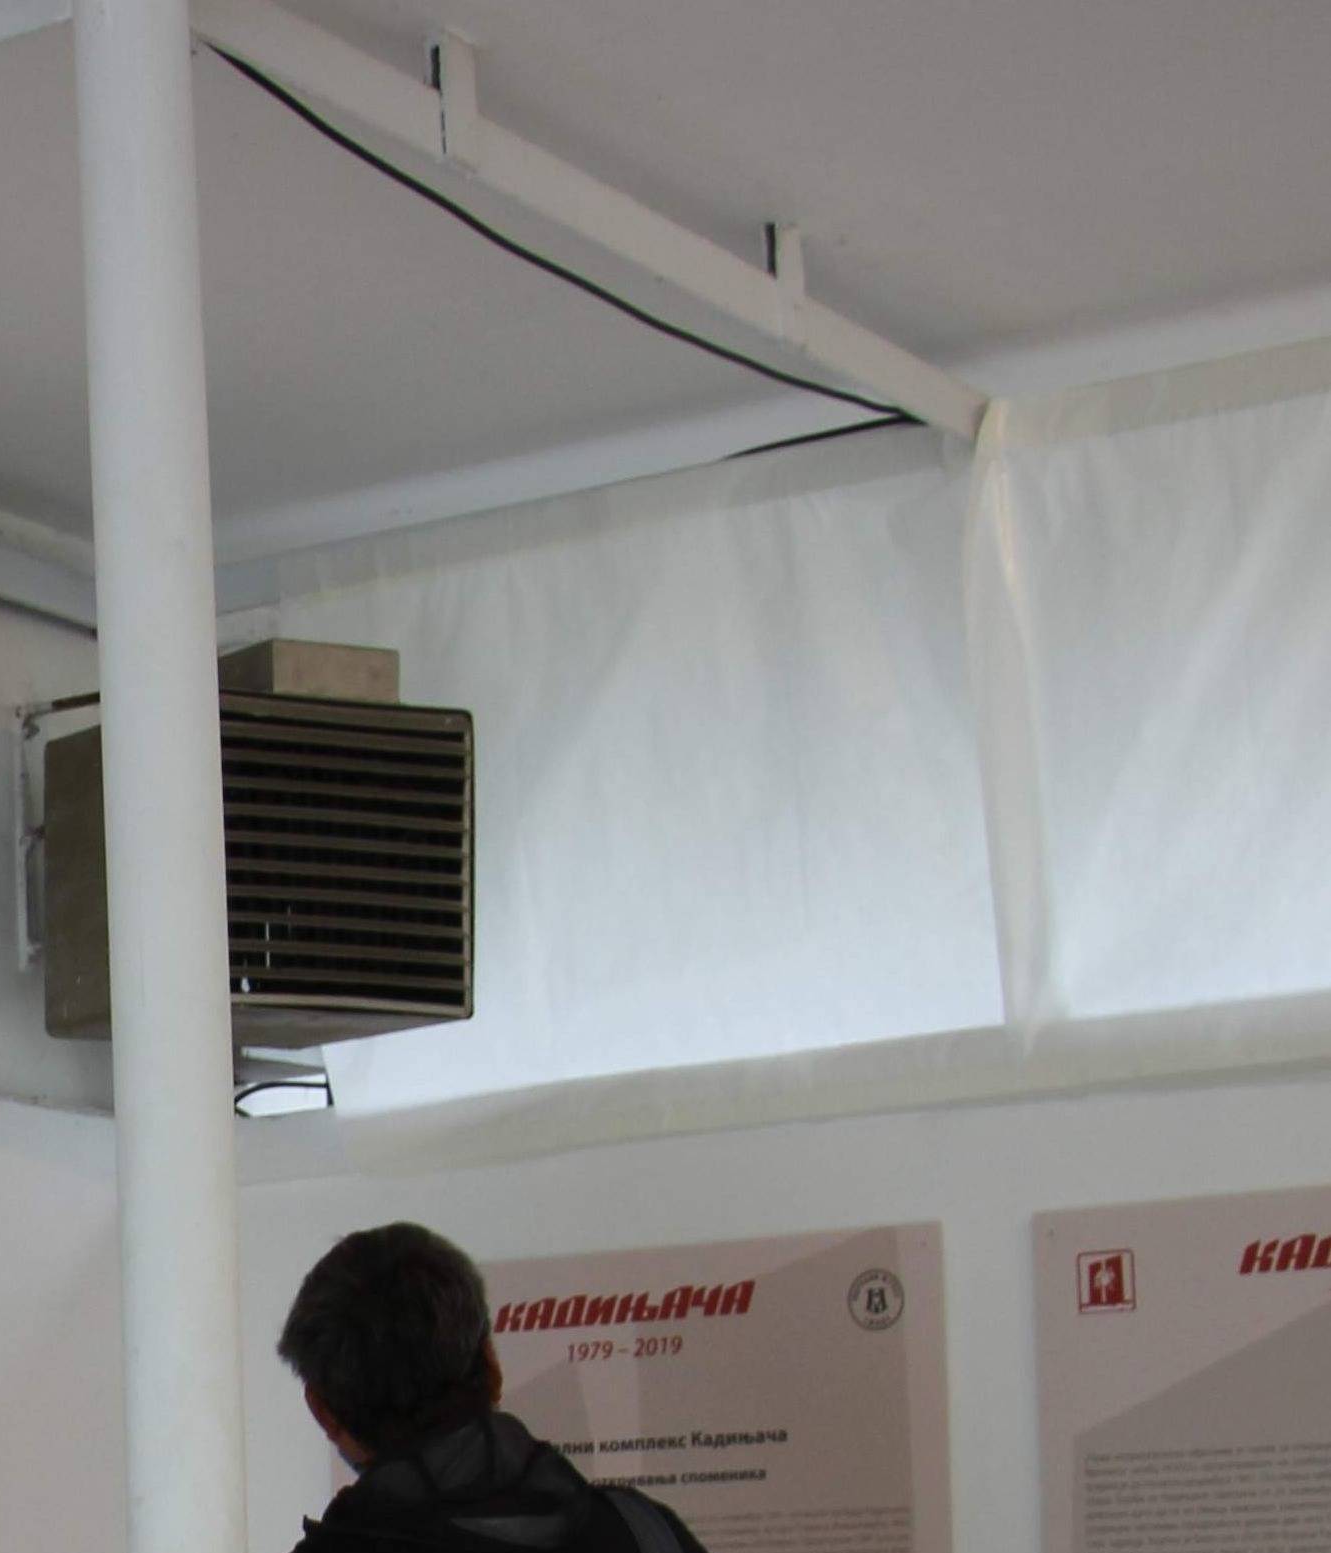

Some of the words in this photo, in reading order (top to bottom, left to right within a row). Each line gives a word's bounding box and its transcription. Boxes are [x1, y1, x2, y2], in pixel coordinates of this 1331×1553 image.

[494, 1280, 755, 1333] КАДИЊАЧА
[567, 1341, 614, 1363] 1979
[633, 1335, 683, 1358] 2019
[599, 1435, 686, 1453] комплекс
[691, 1428, 788, 1449] Кадињача
[680, 1468, 767, 1484] споменика
